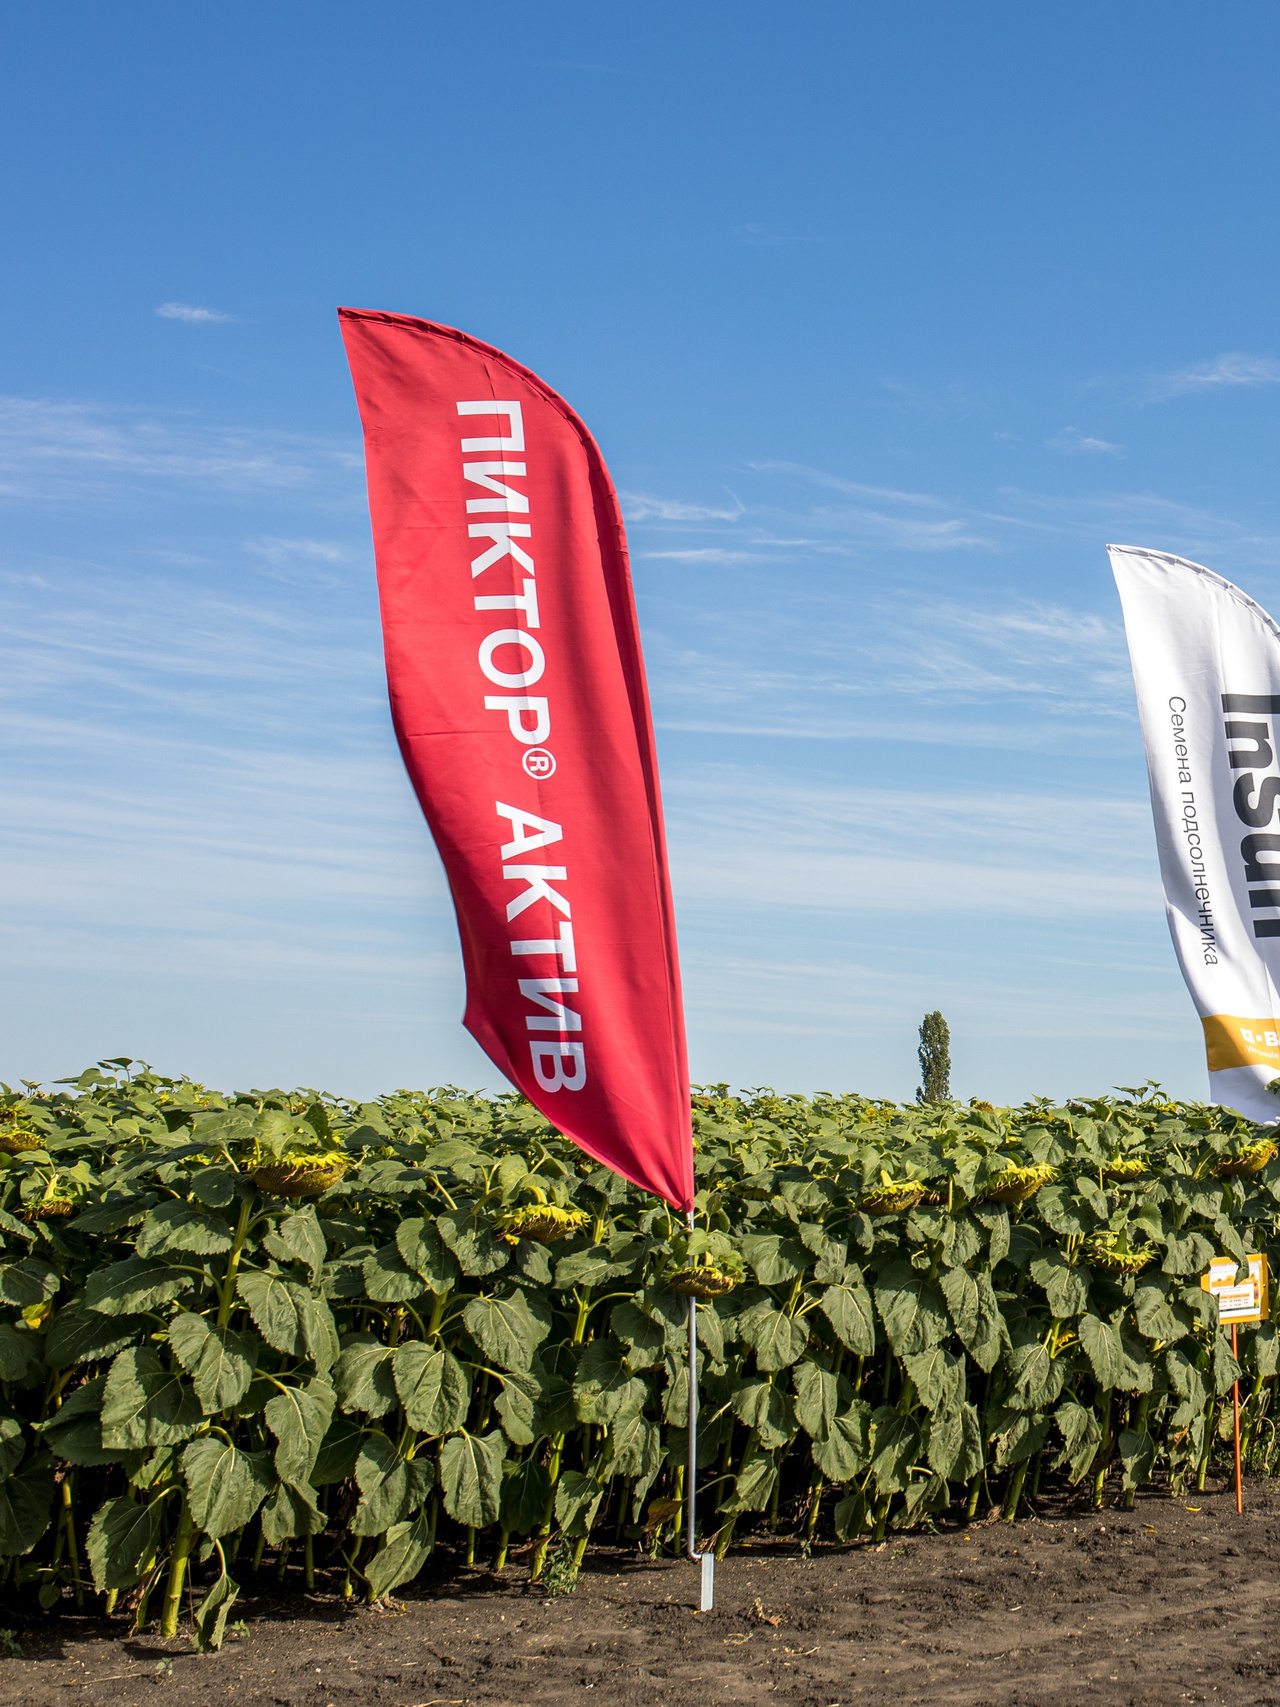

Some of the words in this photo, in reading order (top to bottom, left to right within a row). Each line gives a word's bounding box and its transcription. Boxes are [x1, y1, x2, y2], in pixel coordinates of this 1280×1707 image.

[495, 800, 588, 1094] АКТИВ
[1168, 695, 1192, 785] Семена
[1181, 791, 1219, 966] подсолнечника
[1245, 1045, 1258, 1054] We
